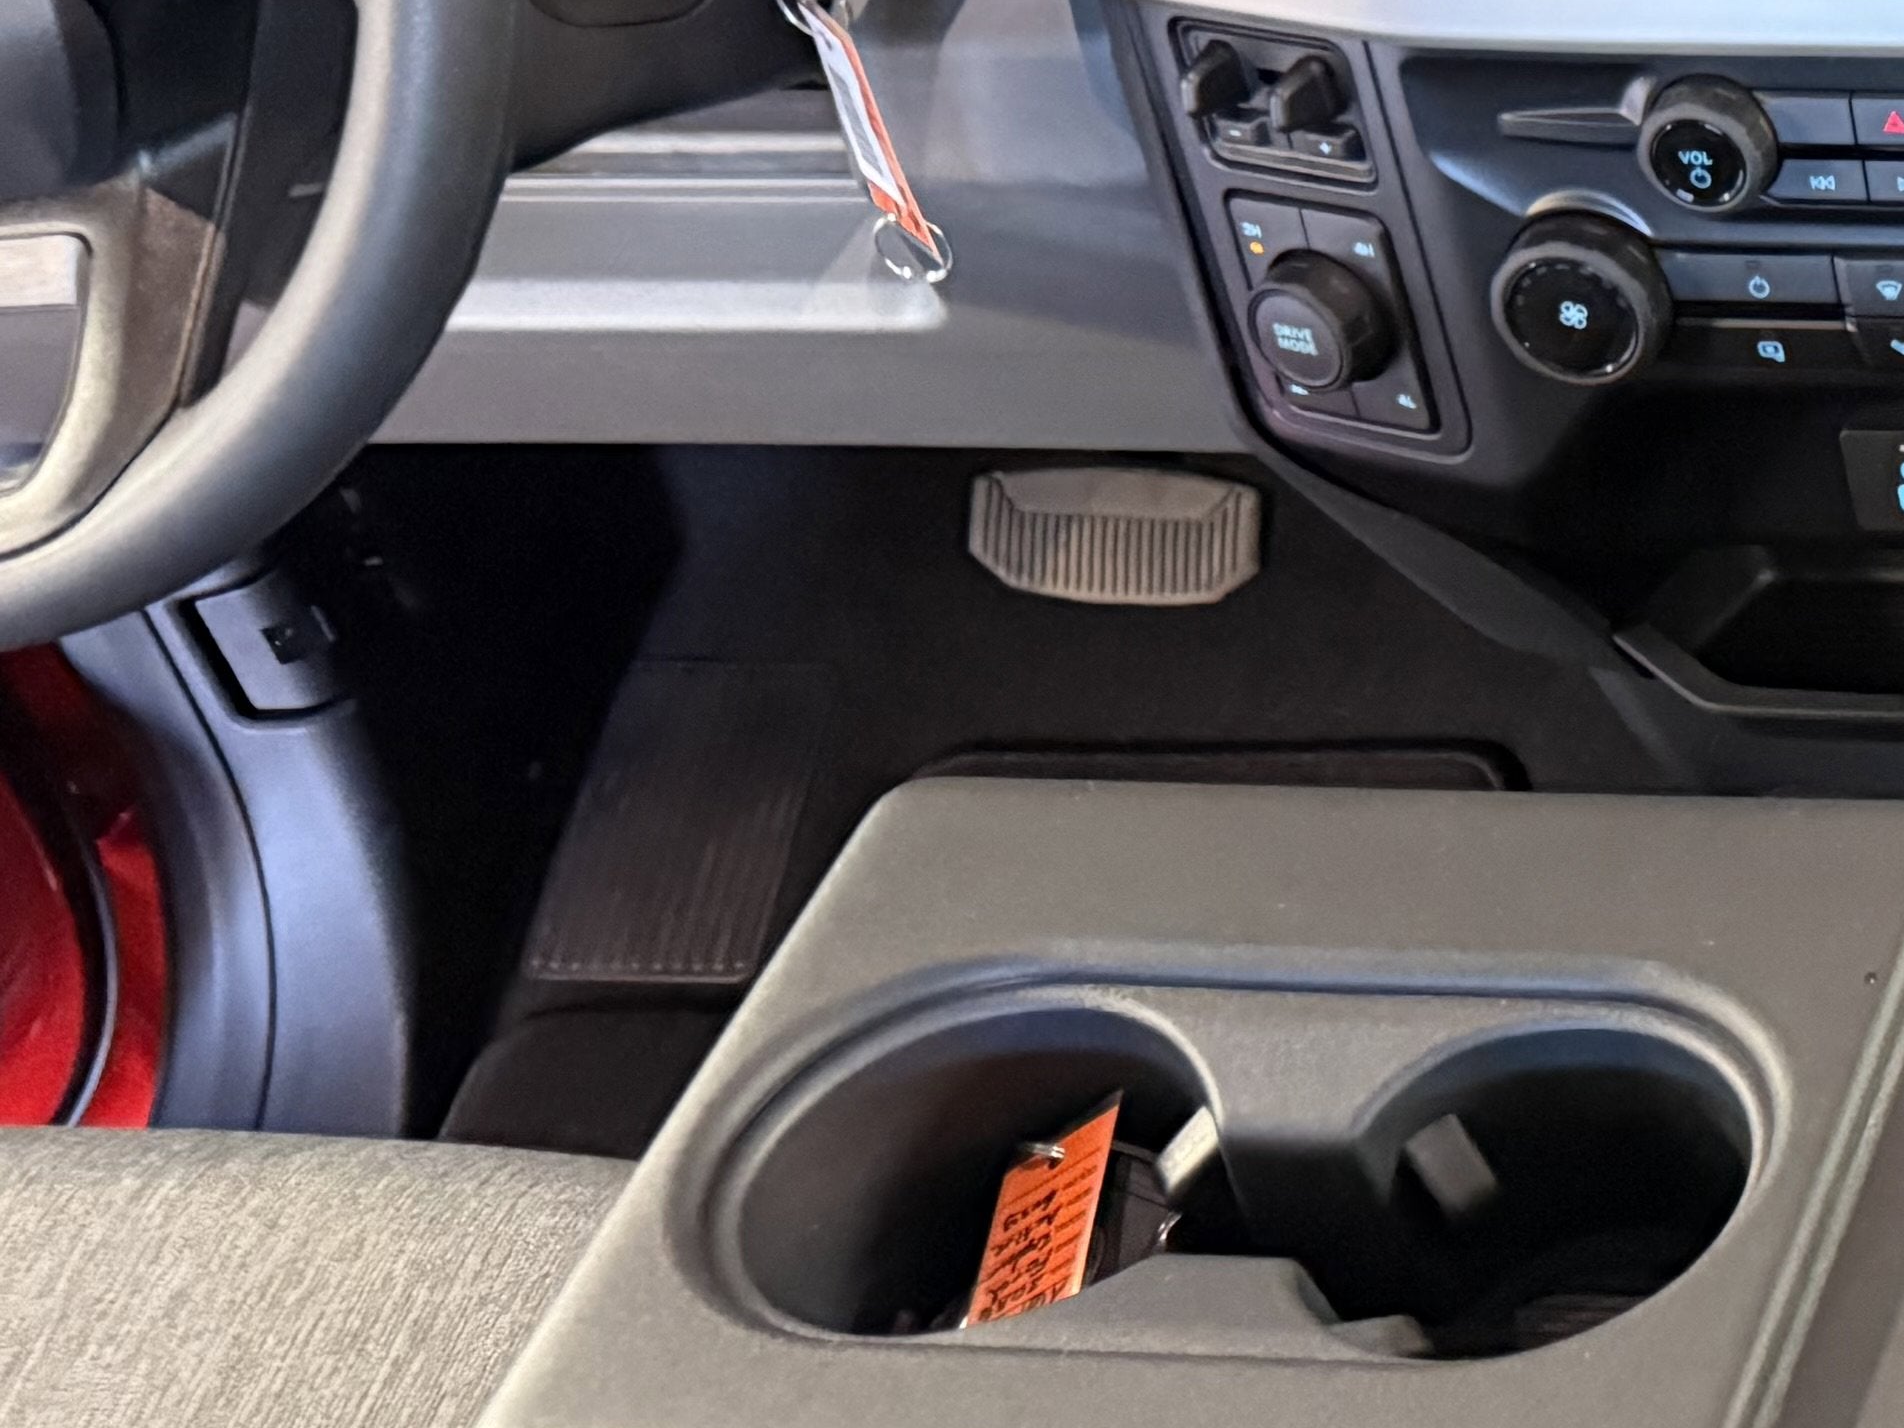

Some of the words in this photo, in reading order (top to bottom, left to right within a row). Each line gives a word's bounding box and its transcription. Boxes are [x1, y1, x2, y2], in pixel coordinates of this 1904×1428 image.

[1678, 149, 1713, 166] VOL
[1272, 323, 1313, 342] DRIVE
[1277, 337, 1319, 356] MODE
